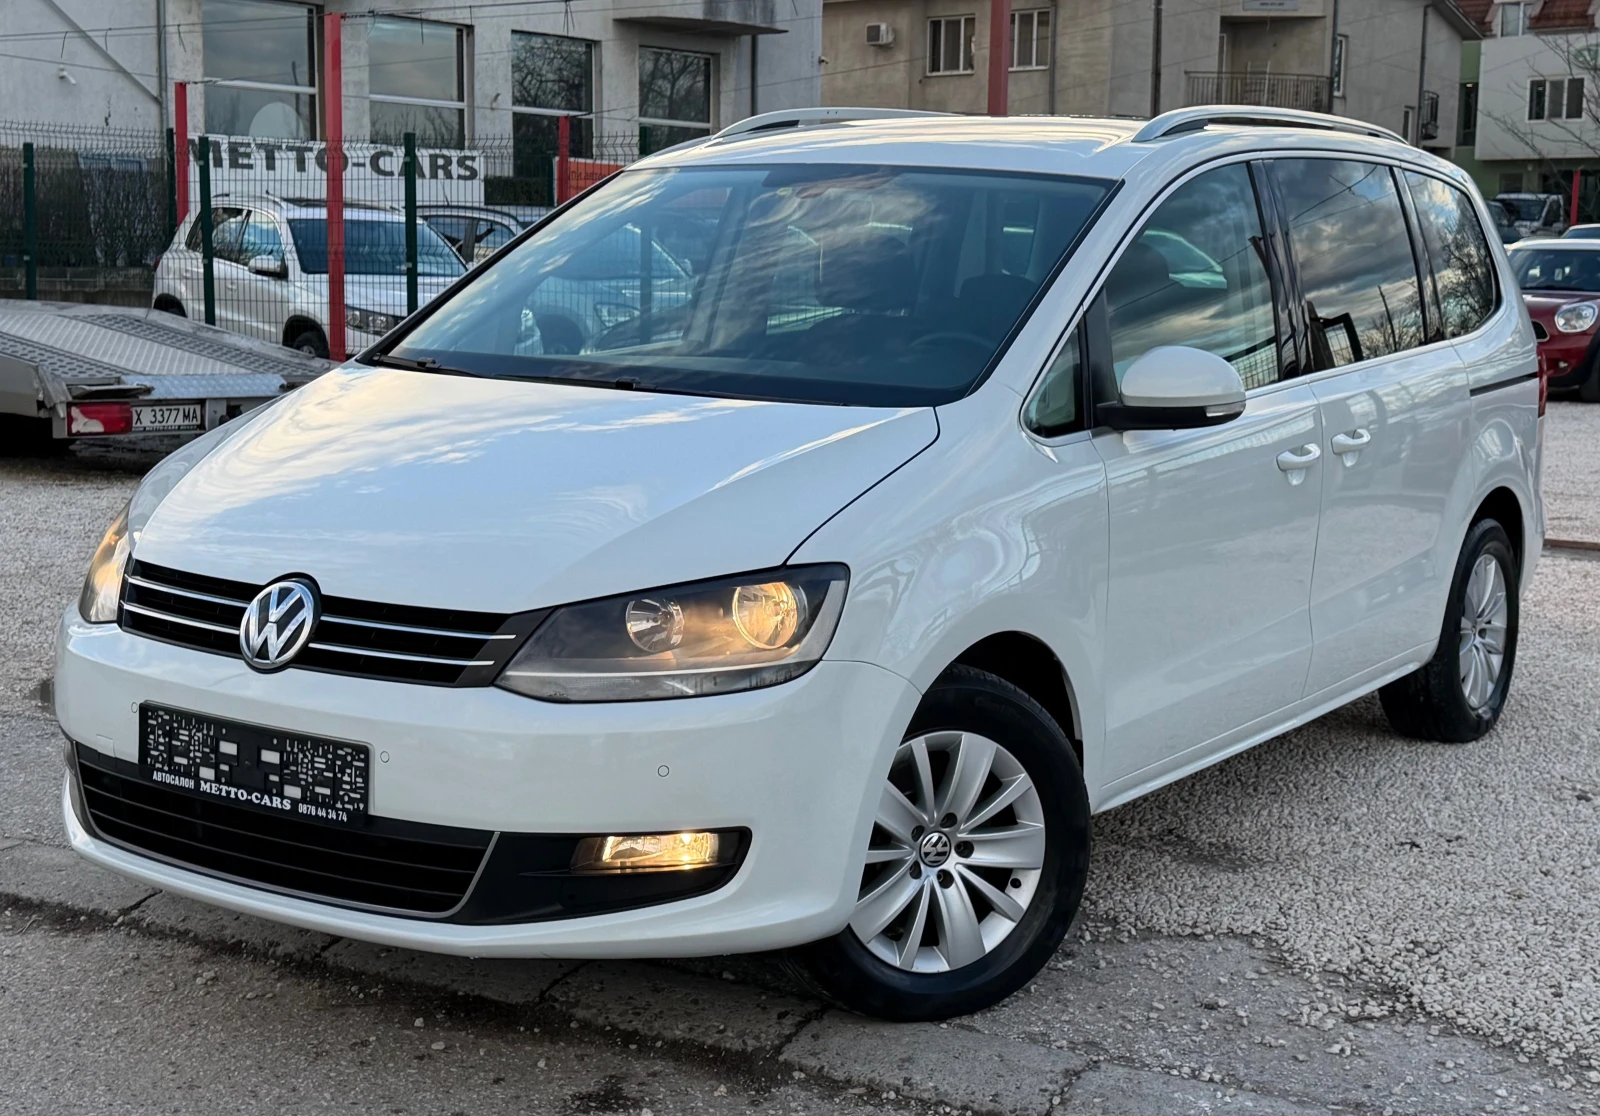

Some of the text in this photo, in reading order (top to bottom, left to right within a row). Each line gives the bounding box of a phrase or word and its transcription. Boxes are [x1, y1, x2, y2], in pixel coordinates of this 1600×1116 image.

[149, 408, 180, 425] 3377
[182, 407, 199, 424] MA
[240, 582, 313, 669] VW
[152, 770, 348, 823] АВТОСАЛОН METTO-CARS 0876 44 34 74
